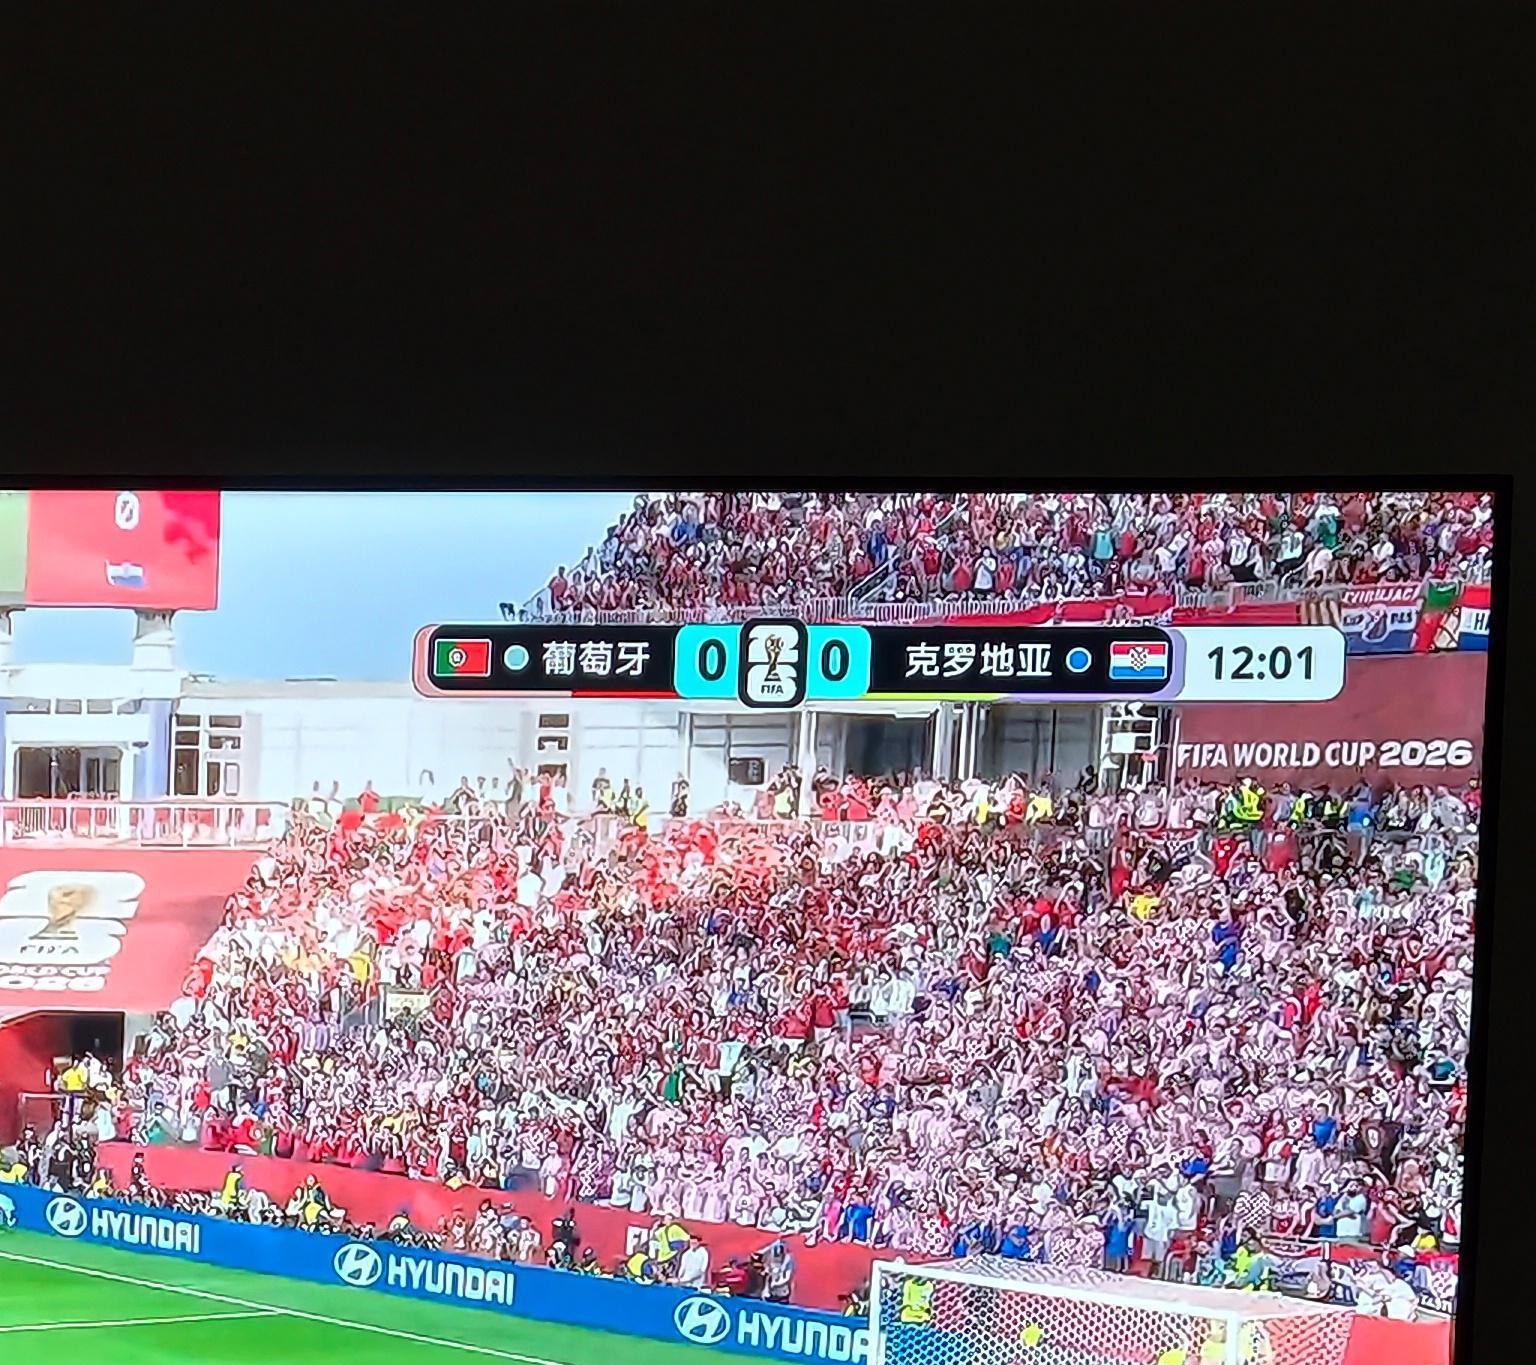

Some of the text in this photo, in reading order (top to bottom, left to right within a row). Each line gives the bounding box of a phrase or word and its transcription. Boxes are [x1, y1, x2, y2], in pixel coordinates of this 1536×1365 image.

[543, 641, 650, 677] 葡萄牙
[698, 639, 727, 681] 0
[821, 639, 850, 681] 0
[905, 641, 1052, 678] 克罗地亚
[1207, 645, 1315, 681] 12:01
[1177, 740, 1473, 768] FIFA WORLD CUP 2026
[91, 1213, 200, 1254] HYUNDAI
[387, 1255, 515, 1306] HYUNDAI
